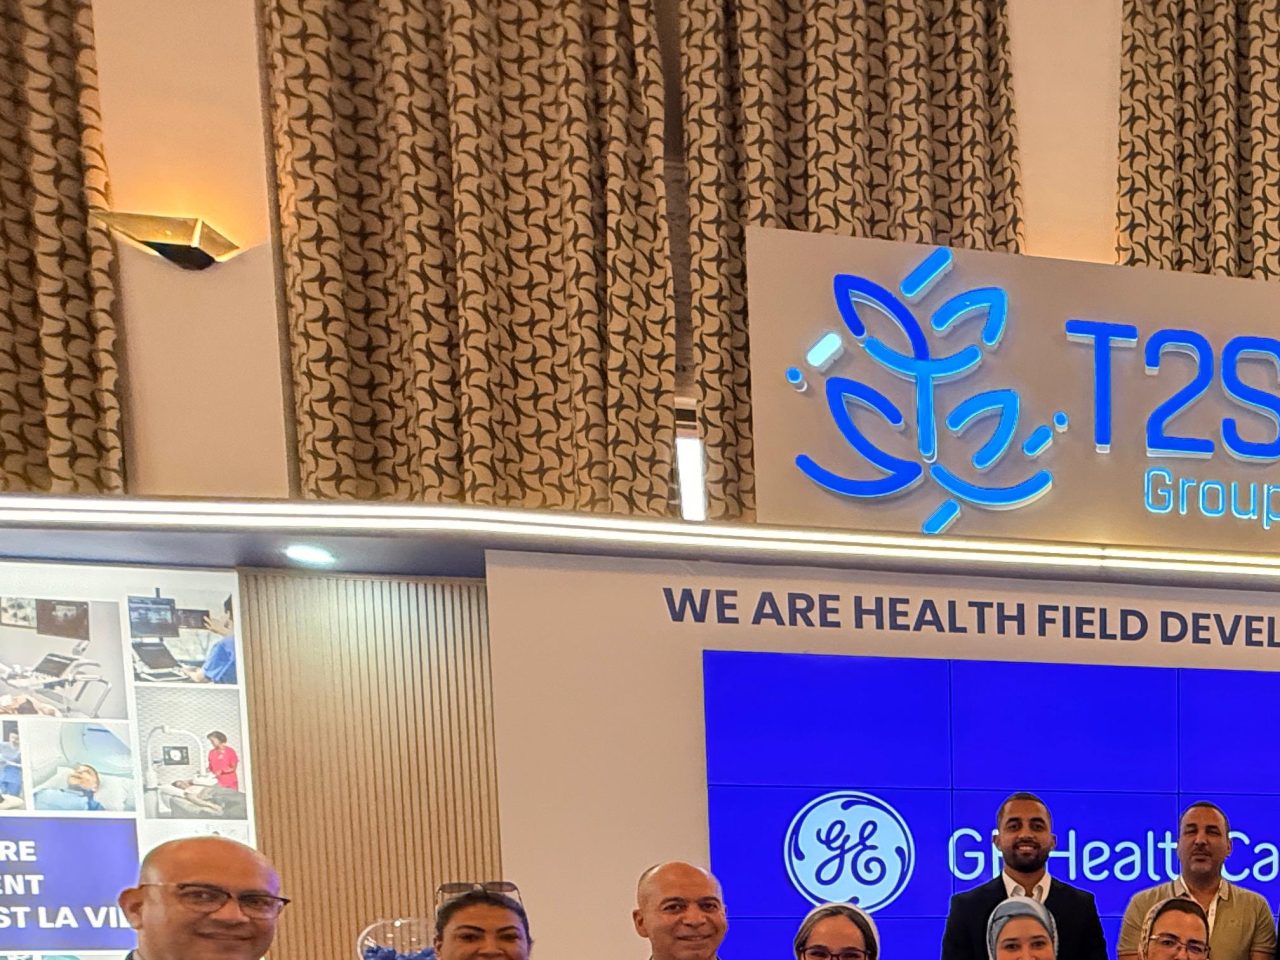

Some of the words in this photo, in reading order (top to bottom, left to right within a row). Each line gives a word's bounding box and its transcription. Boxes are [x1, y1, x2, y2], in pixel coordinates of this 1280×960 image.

[663, 587, 740, 624] WE
[751, 592, 842, 628] ARE
[853, 596, 1026, 636] HEALTH
[1037, 604, 1149, 641] FIELD
[0, 874, 44, 895] NT
[37, 906, 79, 928] LA
